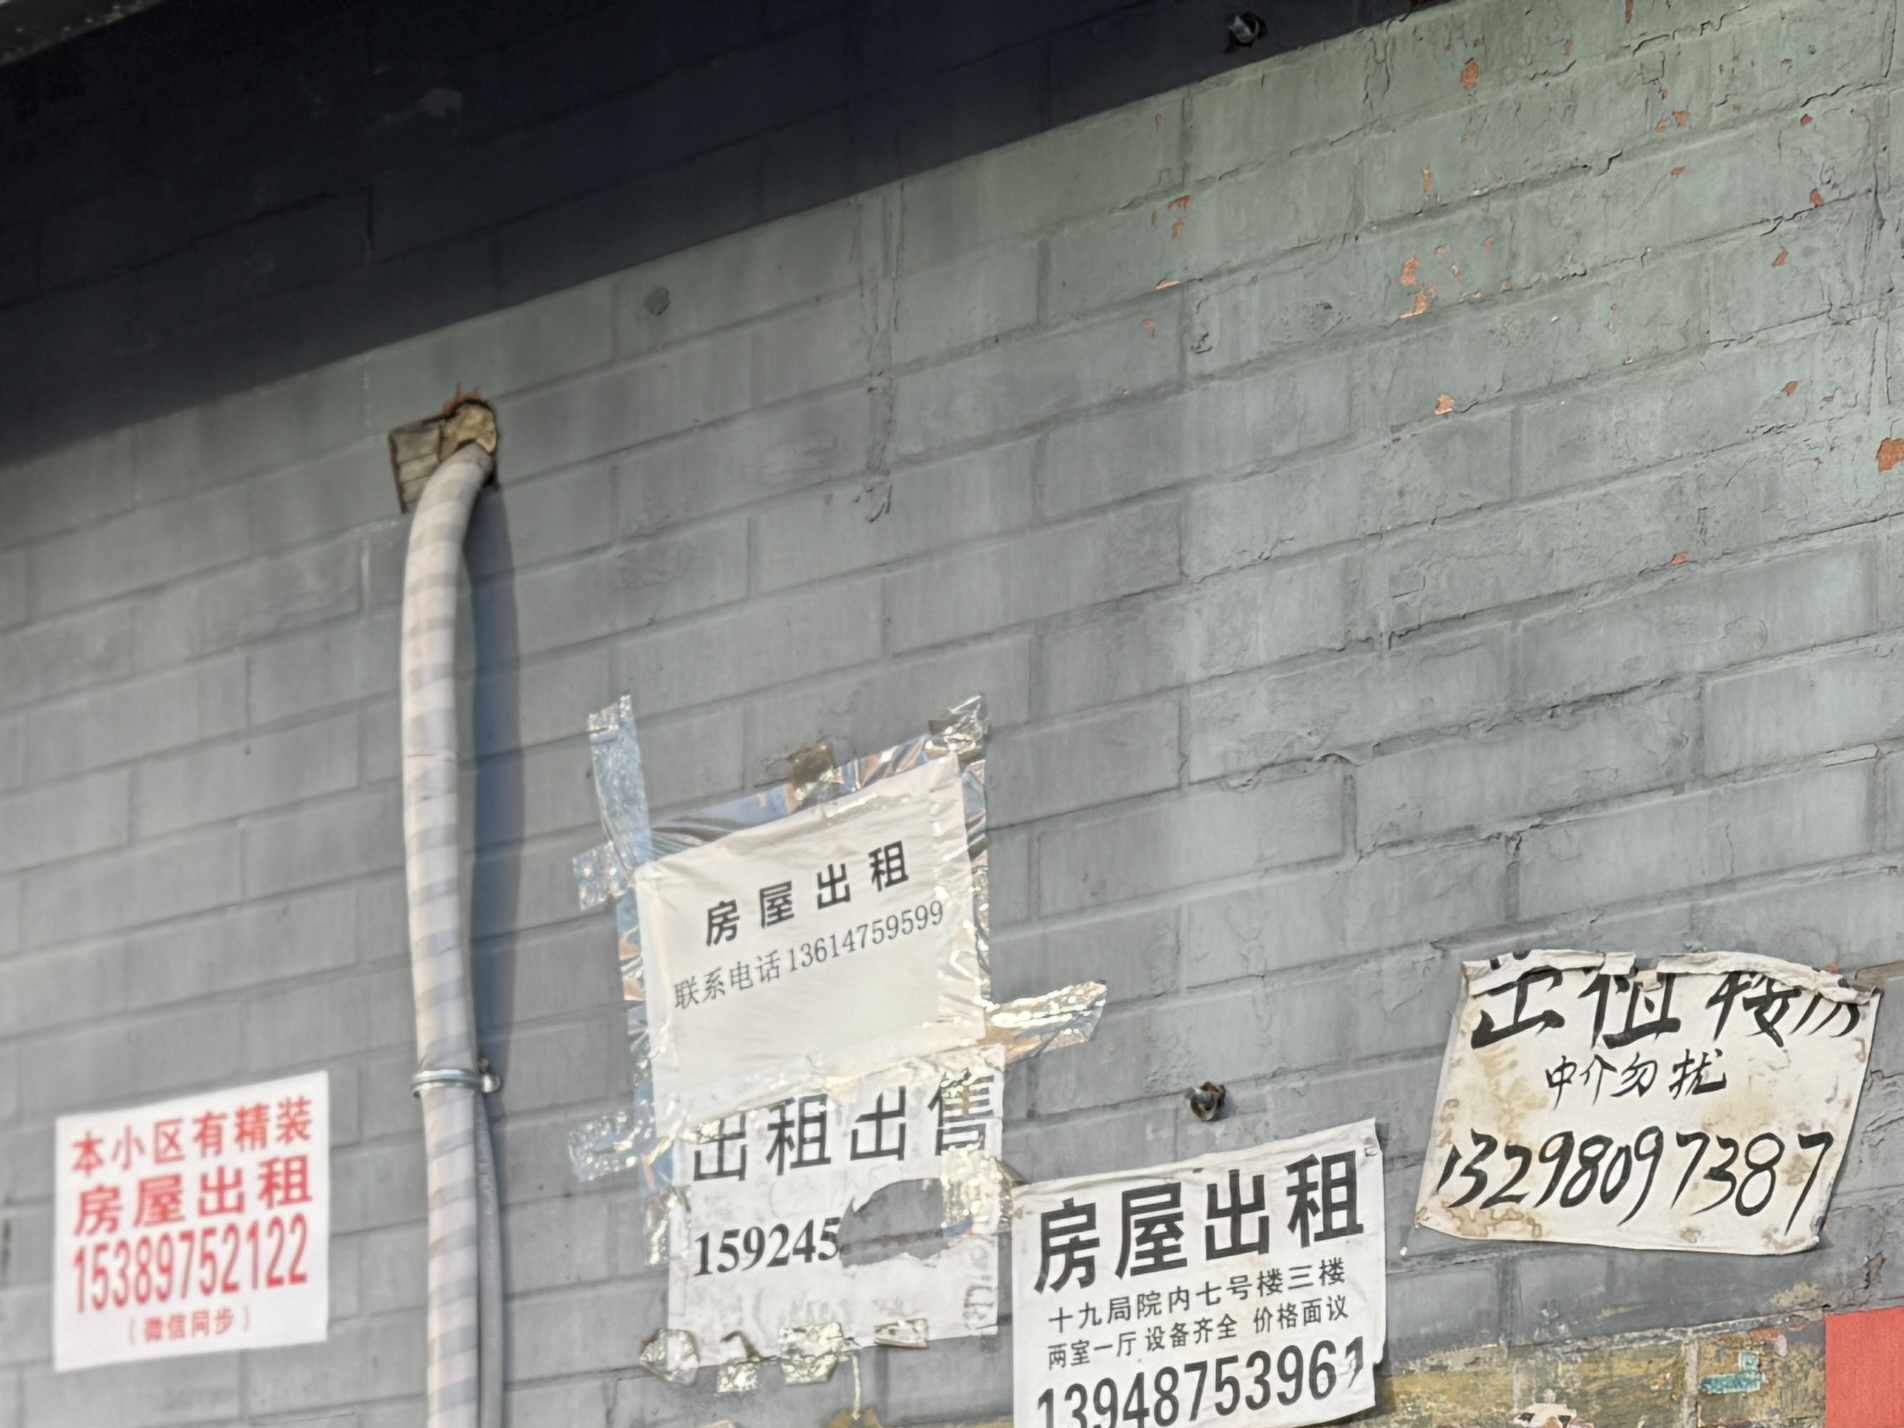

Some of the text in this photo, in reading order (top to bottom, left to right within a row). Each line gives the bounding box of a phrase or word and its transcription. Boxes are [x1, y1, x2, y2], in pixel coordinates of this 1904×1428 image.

[705, 840, 909, 945] 房屋出租
[1545, 1048, 1728, 1111] 中介勿扰
[71, 1095, 313, 1178] 本小区有精装
[692, 1070, 997, 1184] 出租出售
[73, 1154, 313, 1236] 房屋出租
[1034, 1149, 1364, 1295] 房屋出租
[1434, 1125, 1834, 1236] 13298097387
[74, 1214, 308, 1314] 15389752122
[1048, 1256, 1346, 1334] 十九局院内七号楼三楼
[1252, 1294, 1349, 1335] 价格面议
